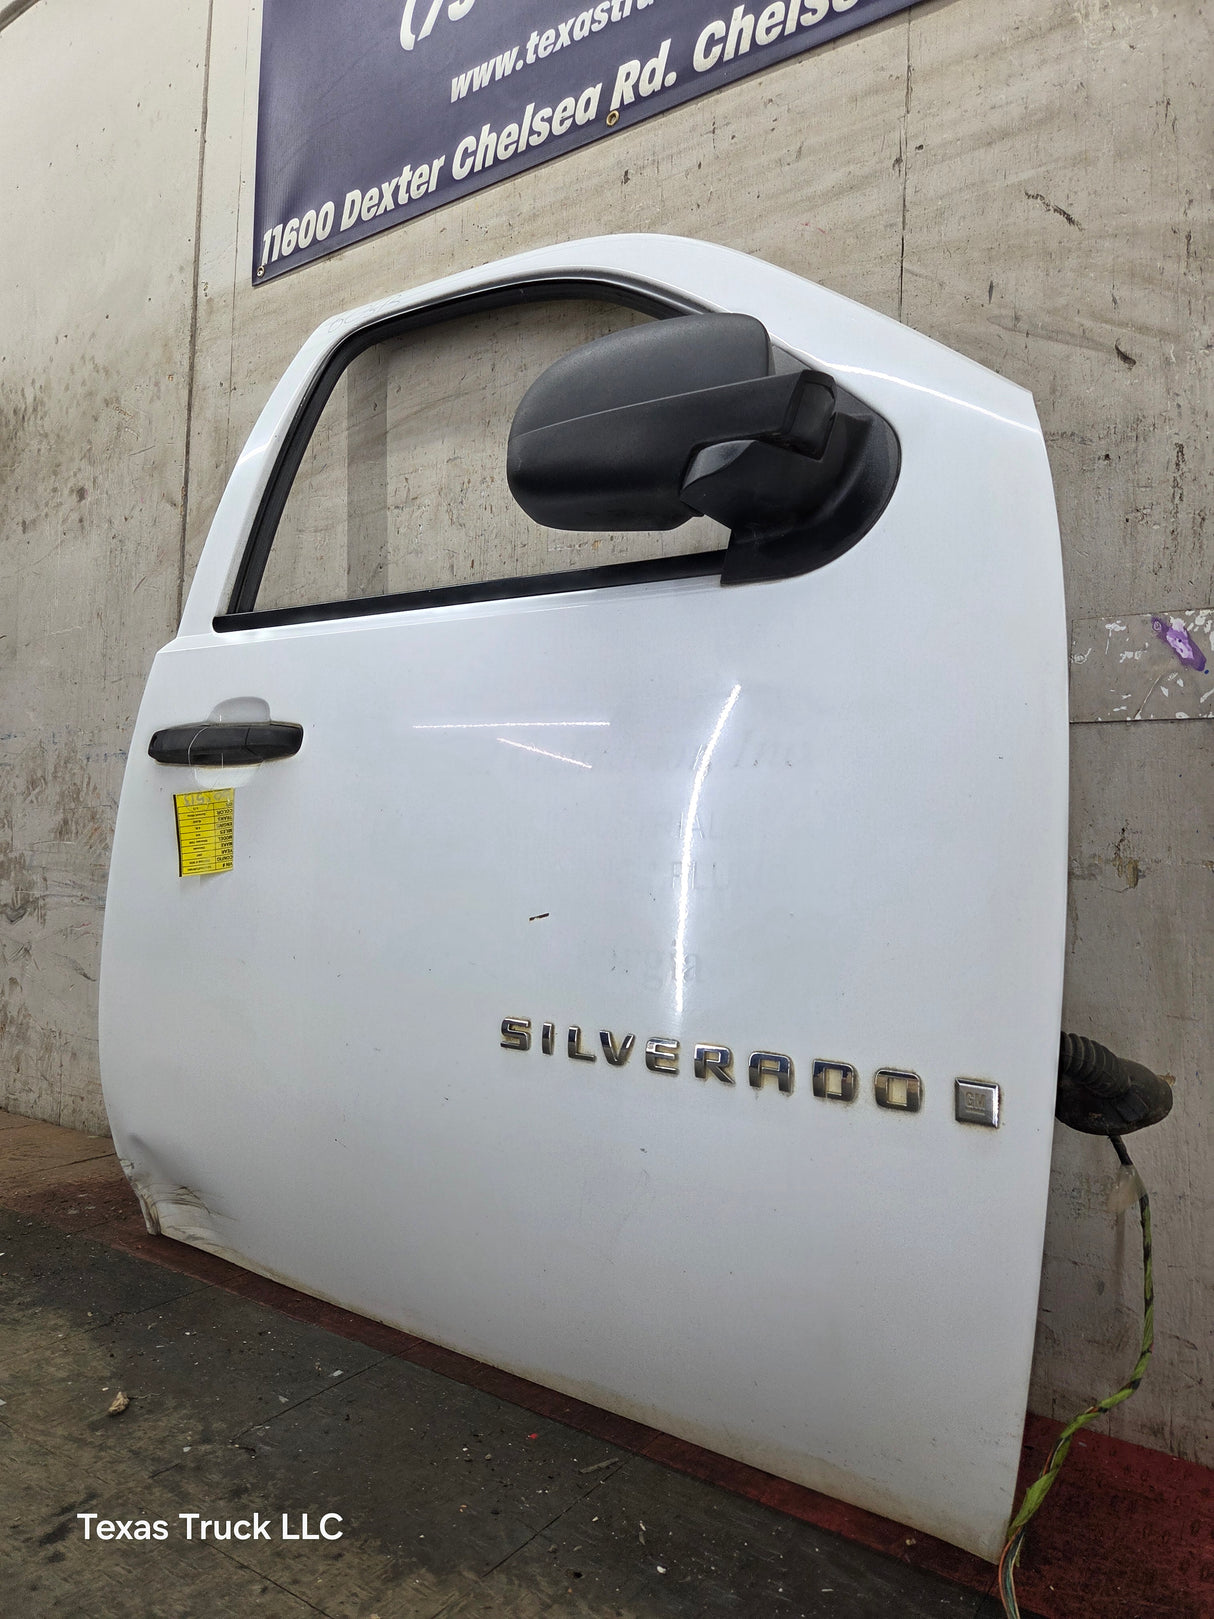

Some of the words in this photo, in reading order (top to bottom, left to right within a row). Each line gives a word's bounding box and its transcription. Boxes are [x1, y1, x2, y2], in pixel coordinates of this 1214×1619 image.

[262, 200, 334, 265] 11600
[340, 155, 445, 232] Dexter
[452, 83, 602, 180] Chelsea
[610, 38, 677, 112] Rd.
[500, 1016, 923, 1113] SILVERADO
